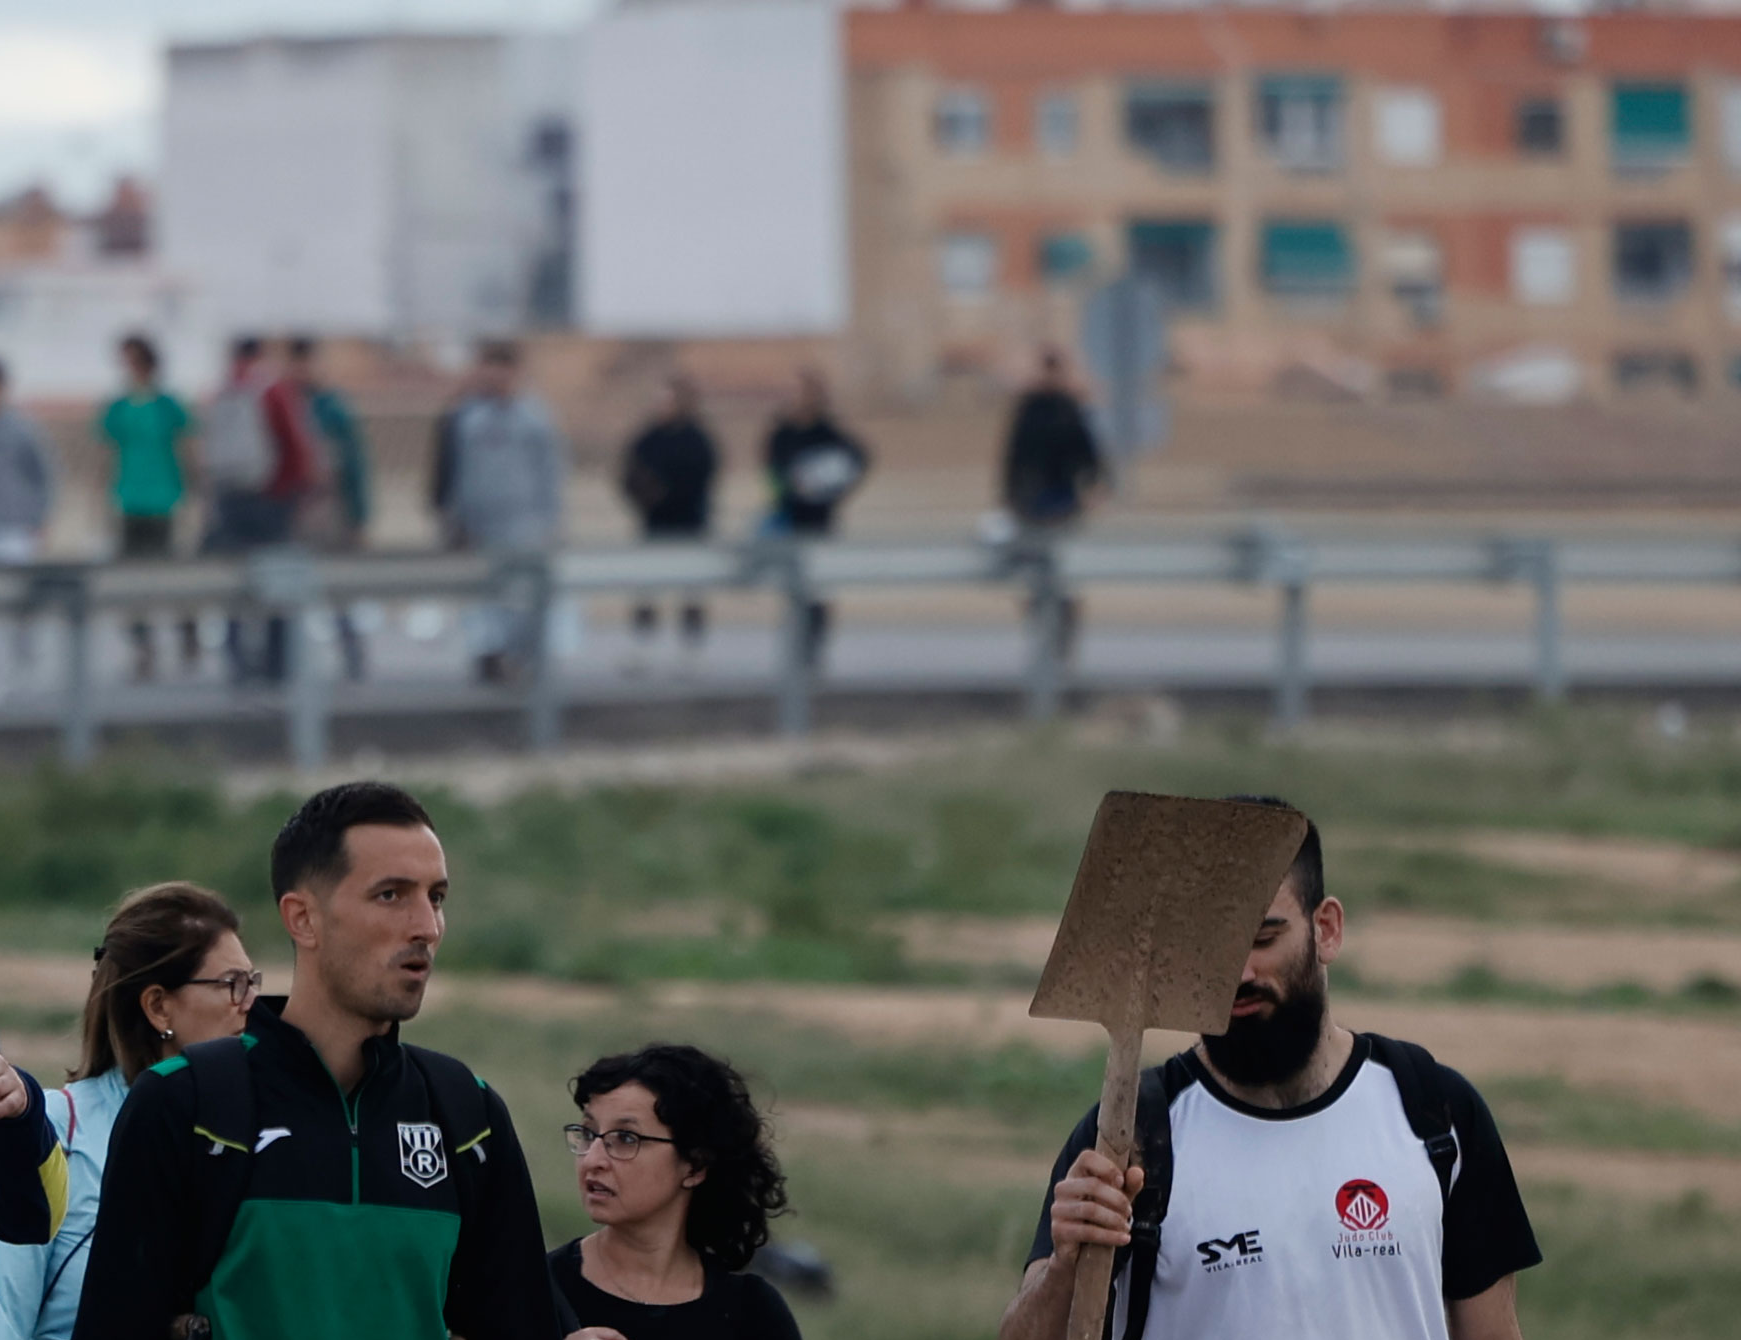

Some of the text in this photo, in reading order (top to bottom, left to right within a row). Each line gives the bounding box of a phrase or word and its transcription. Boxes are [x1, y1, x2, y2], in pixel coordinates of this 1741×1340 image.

[417, 1152, 434, 1173] R
[1338, 1231, 1394, 1243] Judo Club
[1331, 1241, 1402, 1259] Vila-real
